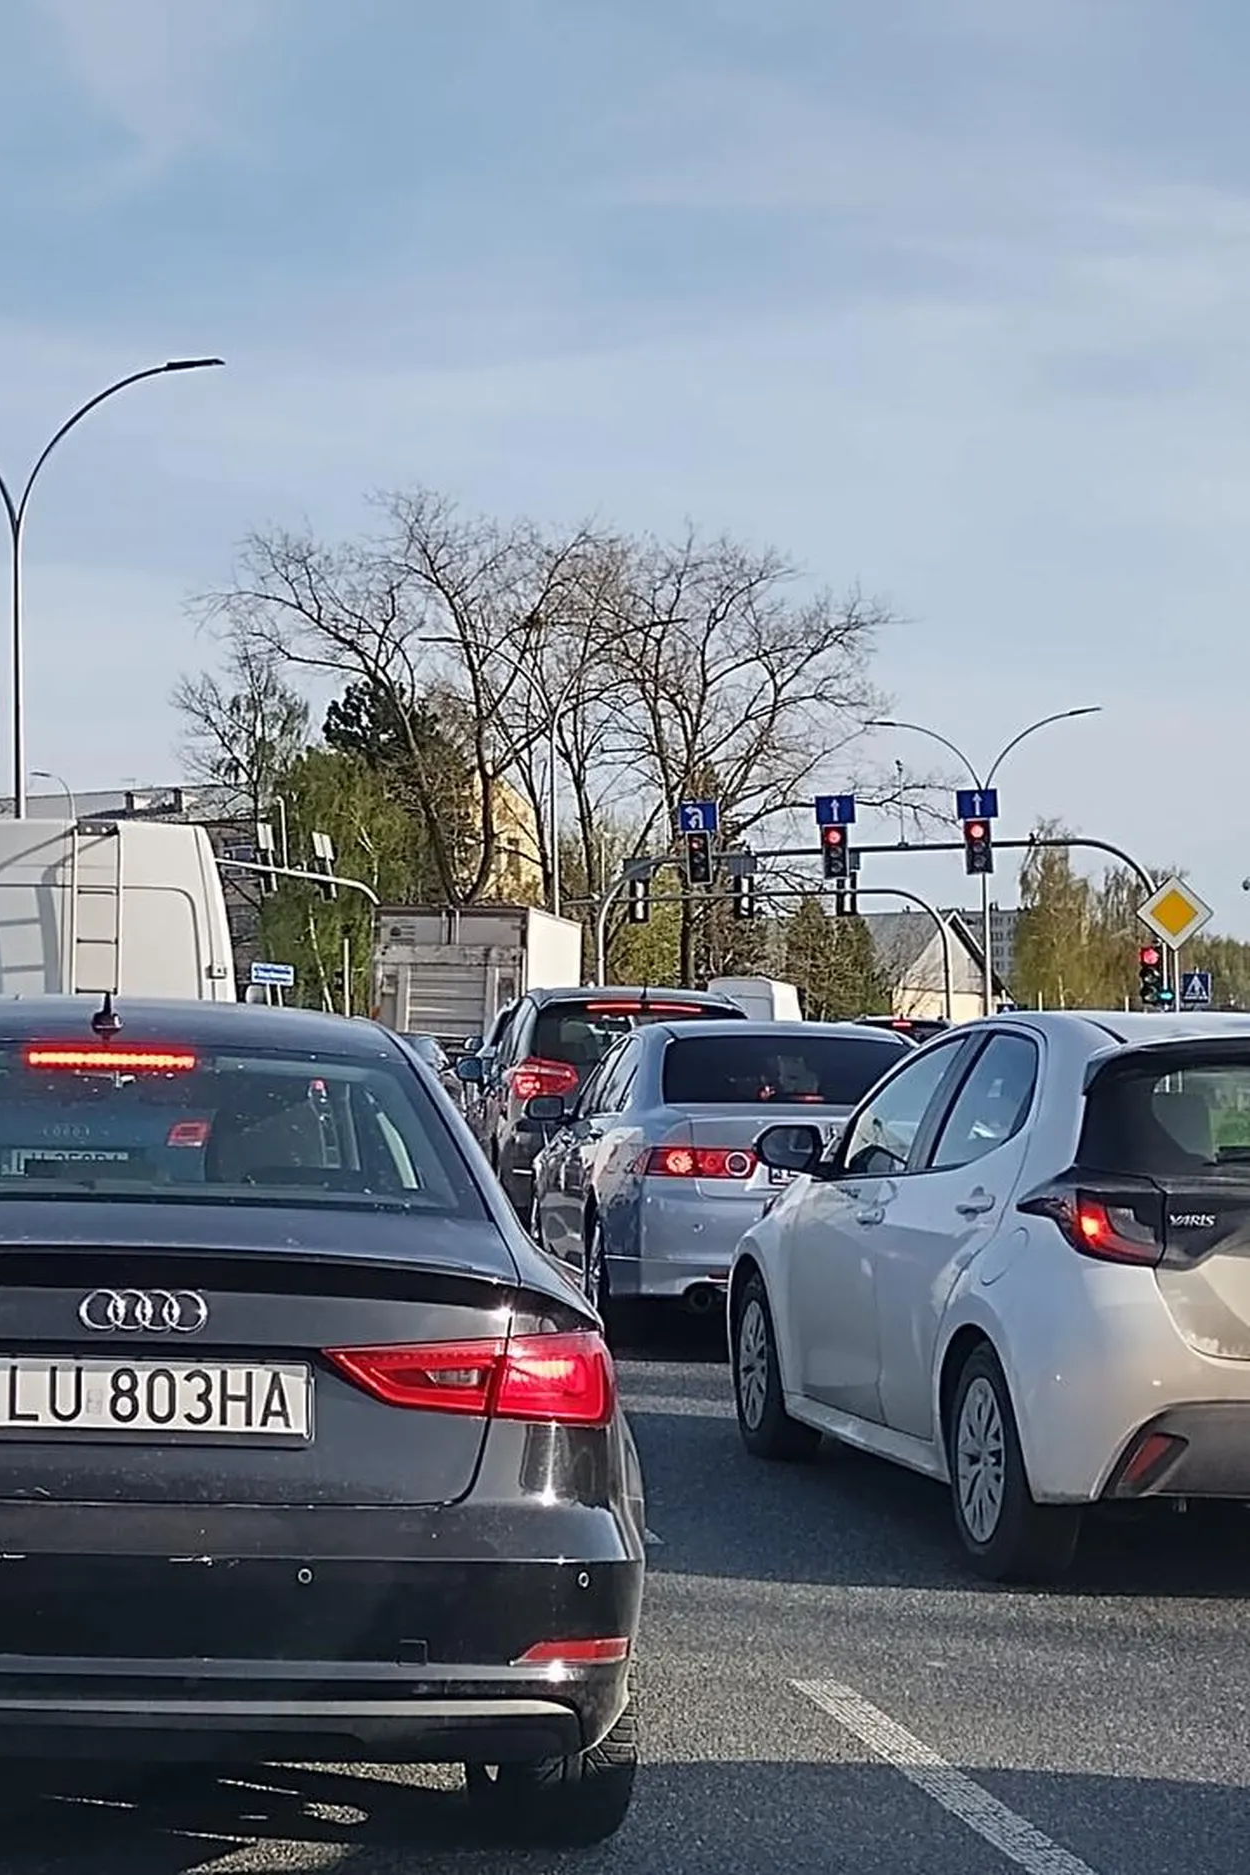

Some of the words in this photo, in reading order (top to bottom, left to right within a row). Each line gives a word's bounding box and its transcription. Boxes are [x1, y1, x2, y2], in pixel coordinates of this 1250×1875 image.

[1170, 1213, 1216, 1227] YARIS
[8, 1365, 83, 1423] LU
[109, 1367, 292, 1429] 803HA
